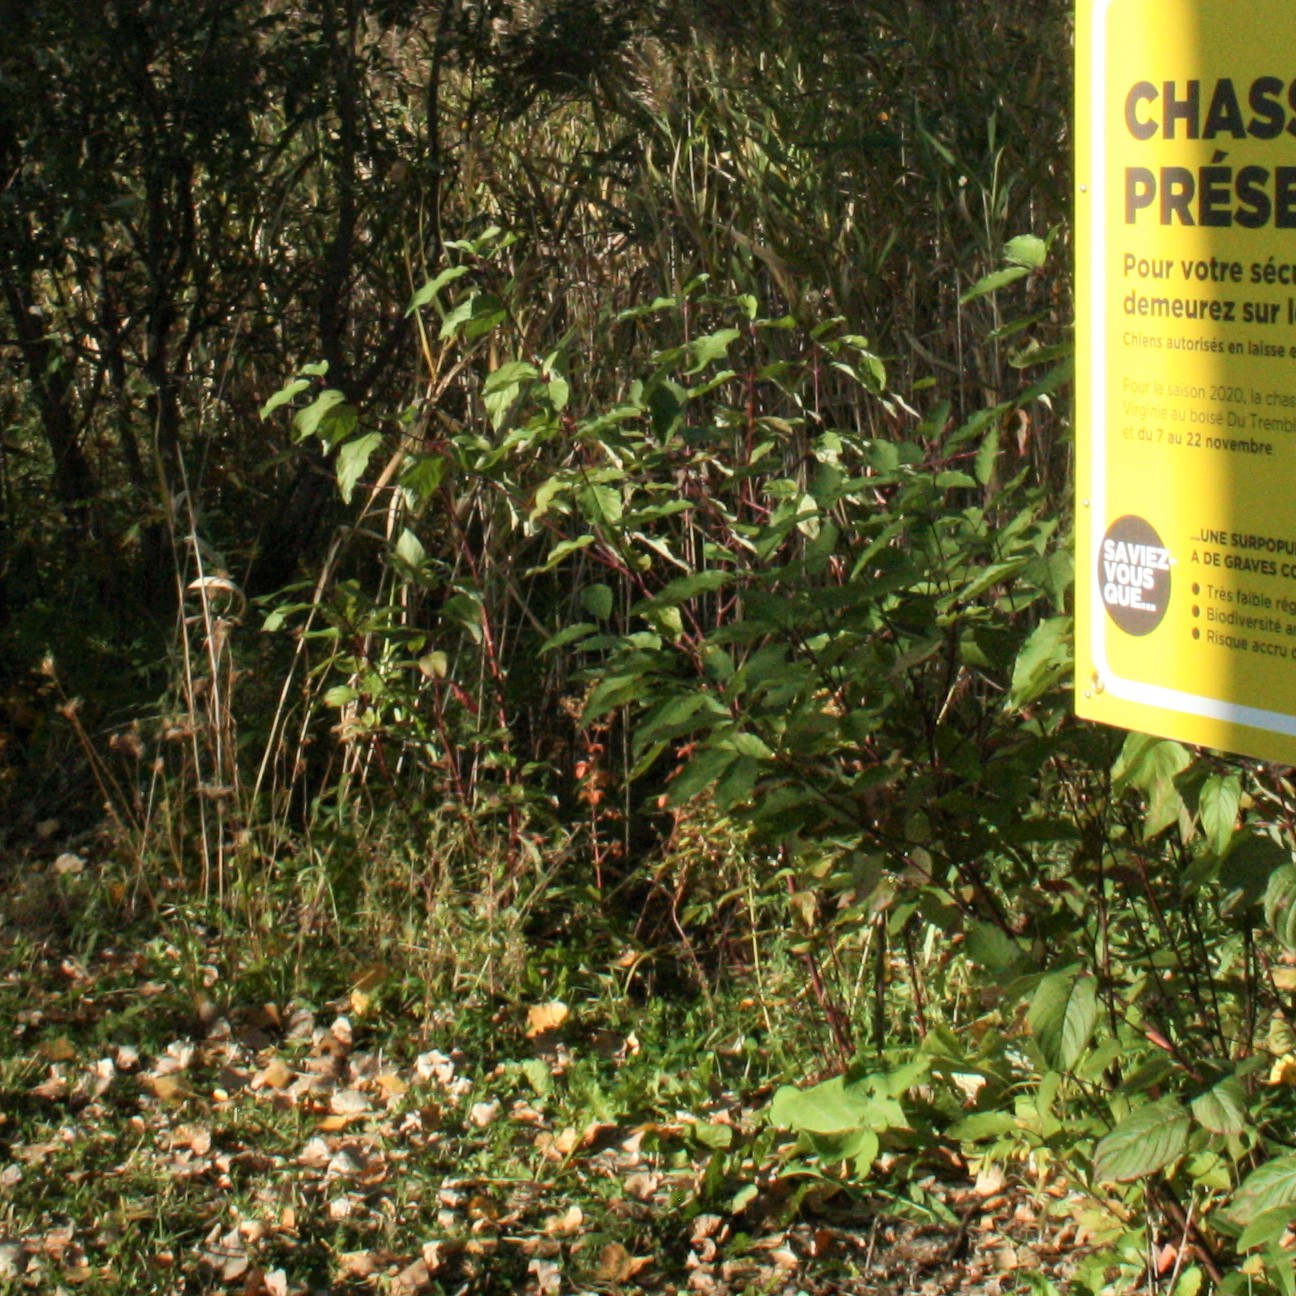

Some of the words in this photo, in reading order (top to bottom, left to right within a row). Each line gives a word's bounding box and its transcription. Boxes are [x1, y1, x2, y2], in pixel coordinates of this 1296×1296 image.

[1123, 253, 1173, 279] Pour
[1180, 256, 1242, 282] votre
[1123, 290, 1235, 321] demeurez
[1242, 303, 1280, 324] sur
[1122, 332, 1162, 349] Chiens
[1166, 336, 1224, 353] autorisés
[1227, 343, 1244, 355] en
[1247, 341, 1285, 358] laisse
[1122, 378, 1150, 395] Pour
[1153, 381, 1163, 396] la
[1167, 383, 1205, 400] saison
[1209, 385, 1246, 406] 2020,
[1249, 389, 1262, 405] la
[1121, 401, 1167, 421] Virginie
[1171, 409, 1185, 422] au
[1190, 408, 1224, 426] boisé
[1226, 411, 1245, 428] Du
[1122, 426, 1133, 441] et
[1137, 427, 1152, 443] du
[1156, 429, 1165, 444] 7
[1167, 434, 1182, 446] au
[1186, 432, 1201, 448] 22
[1103, 561, 1154, 590] VOUS
[1190, 550, 1199, 564] A
[1203, 552, 1220, 568] DE
[1223, 555, 1277, 576] GRAVES
[1103, 582, 1156, 612] QUE...
[1206, 585, 1233, 603] Très
[1235, 589, 1272, 609] faible
[1206, 607, 1281, 634] Biodiversité
[1206, 629, 1248, 651] Risque
[1251, 641, 1287, 658] accru
